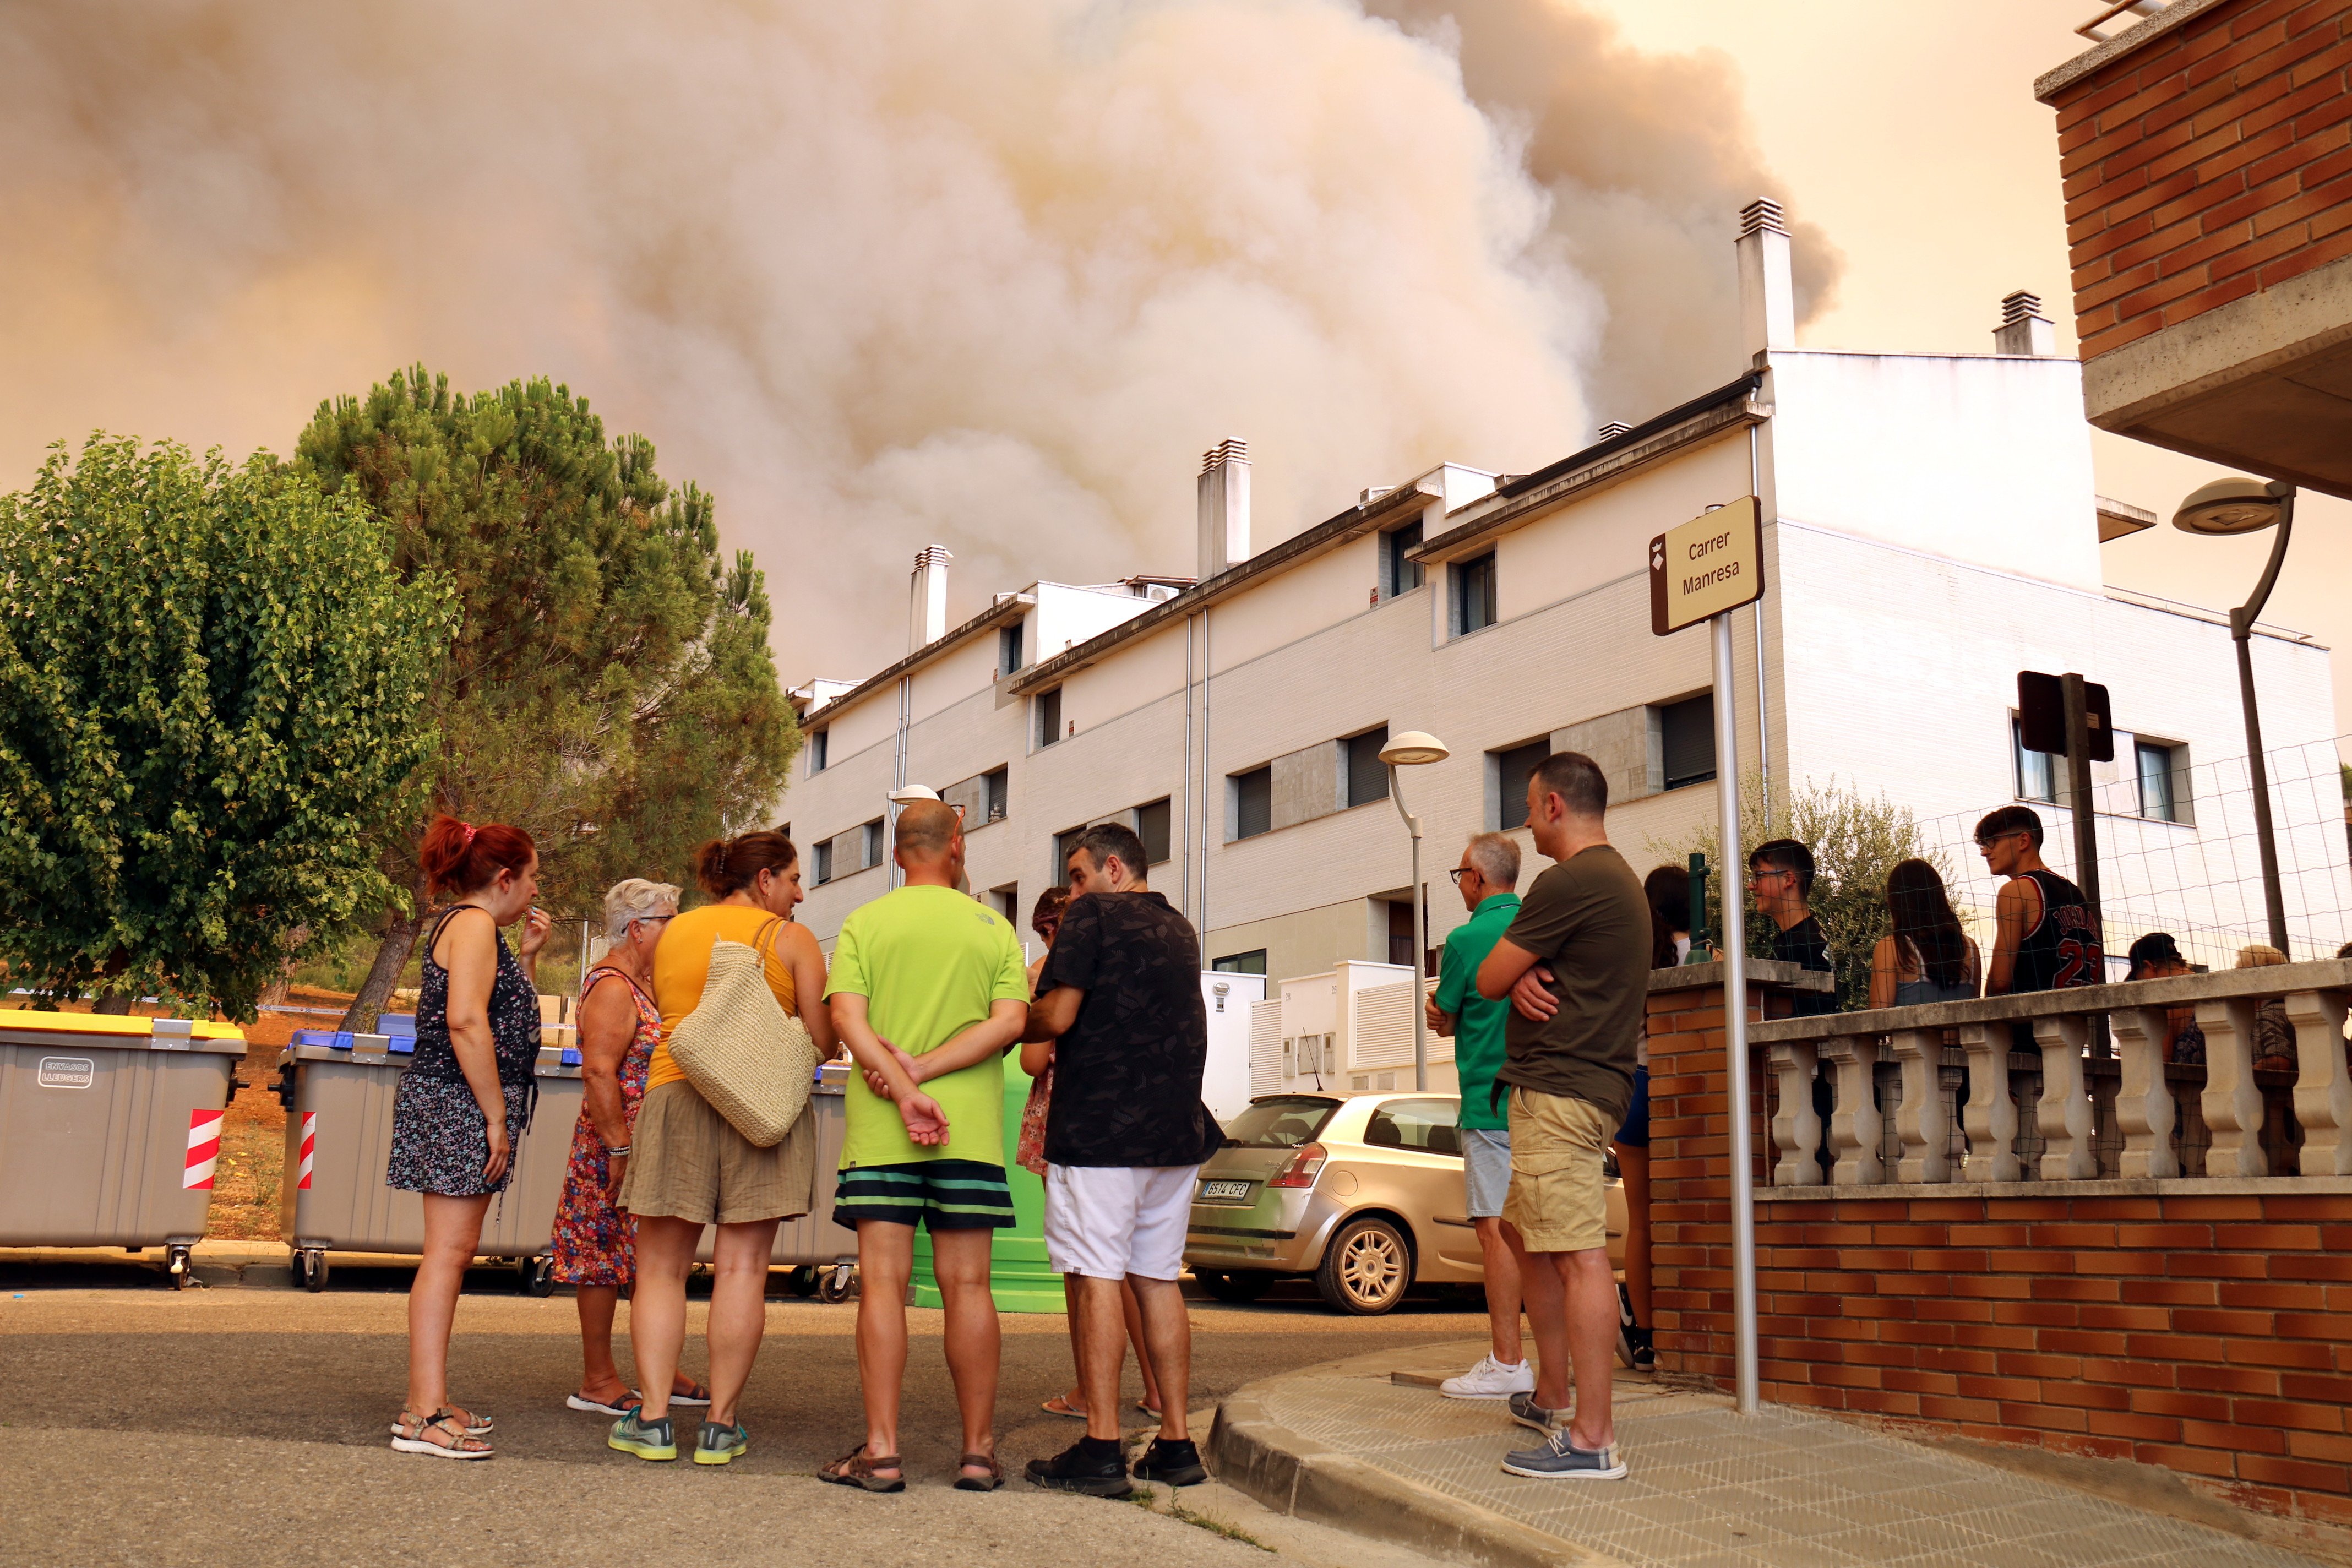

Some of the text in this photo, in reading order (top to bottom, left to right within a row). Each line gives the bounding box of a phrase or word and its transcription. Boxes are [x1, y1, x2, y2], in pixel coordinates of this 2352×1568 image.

[1689, 531, 1730, 560] Carrer
[1683, 561, 1740, 596] Manresa
[2051, 938, 2101, 990] 23
[1331, 985, 1337, 994] 26
[1285, 992, 1291, 1001] 28
[45, 1061, 89, 1072] ENVASOS
[42, 1072, 90, 1083] LLEUGERS
[1208, 1183, 1246, 1195] 6514 CFC
